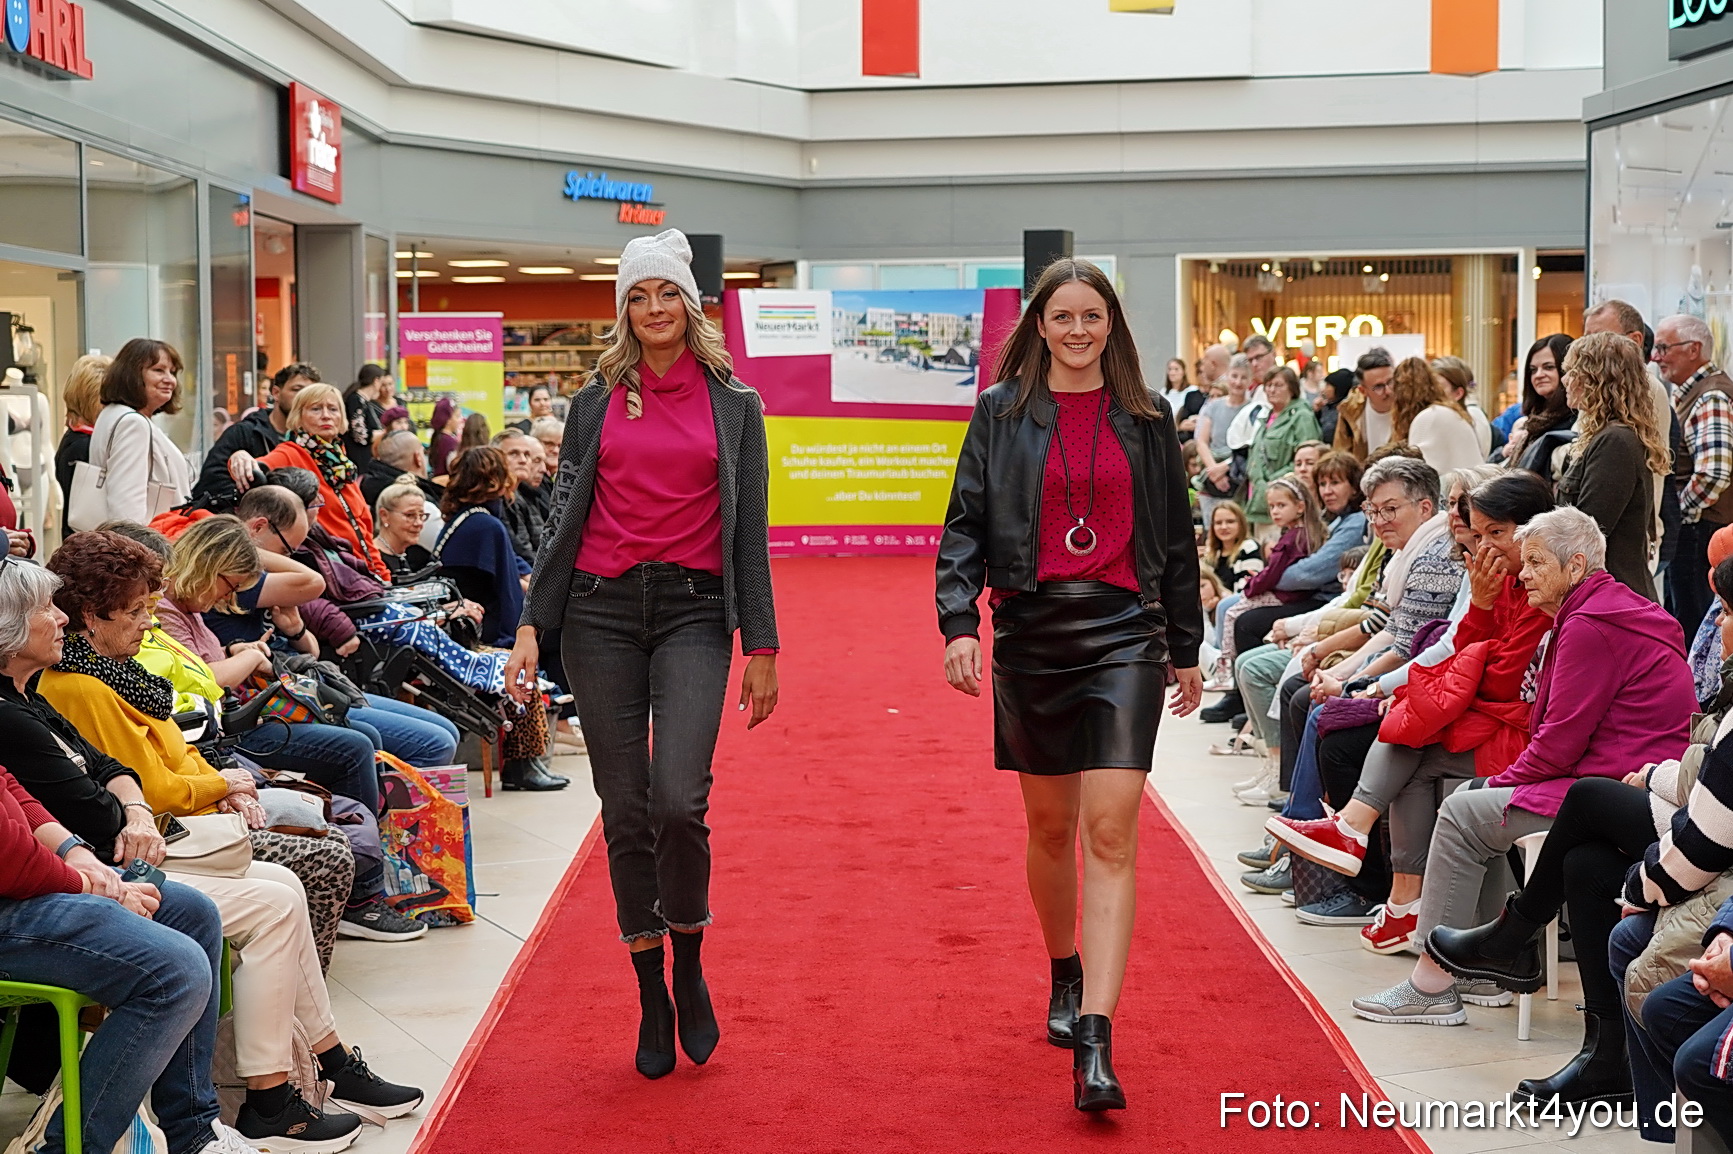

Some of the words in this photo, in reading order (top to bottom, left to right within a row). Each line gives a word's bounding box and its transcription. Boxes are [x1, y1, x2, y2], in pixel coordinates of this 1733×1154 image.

[564, 170, 653, 201] Spielwaren
[755, 322, 819, 332] NeuerMarkt
[404, 329, 474, 342] Verschenken
[475, 328, 494, 341] Sie
[427, 341, 494, 353] Gutscheine!
[790, 443, 804, 454] Du
[805, 443, 846, 454] würdest
[847, 444, 858, 455] ja
[860, 443, 884, 454] nicht
[886, 445, 898, 453] an
[900, 443, 930, 453] einem
[932, 443, 947, 454] Ort
[781, 456, 817, 467] Schuhe
[818, 456, 856, 467] kaufen,
[858, 456, 874, 466] ein
[876, 456, 917, 466] Workout
[918, 456, 956, 466] machen
[789, 469, 809, 479] und
[810, 469, 845, 479] deinen
[846, 469, 909, 479] Traumurlaub
[910, 468, 949, 478] buchen.
[858, 490, 872, 501] Du
